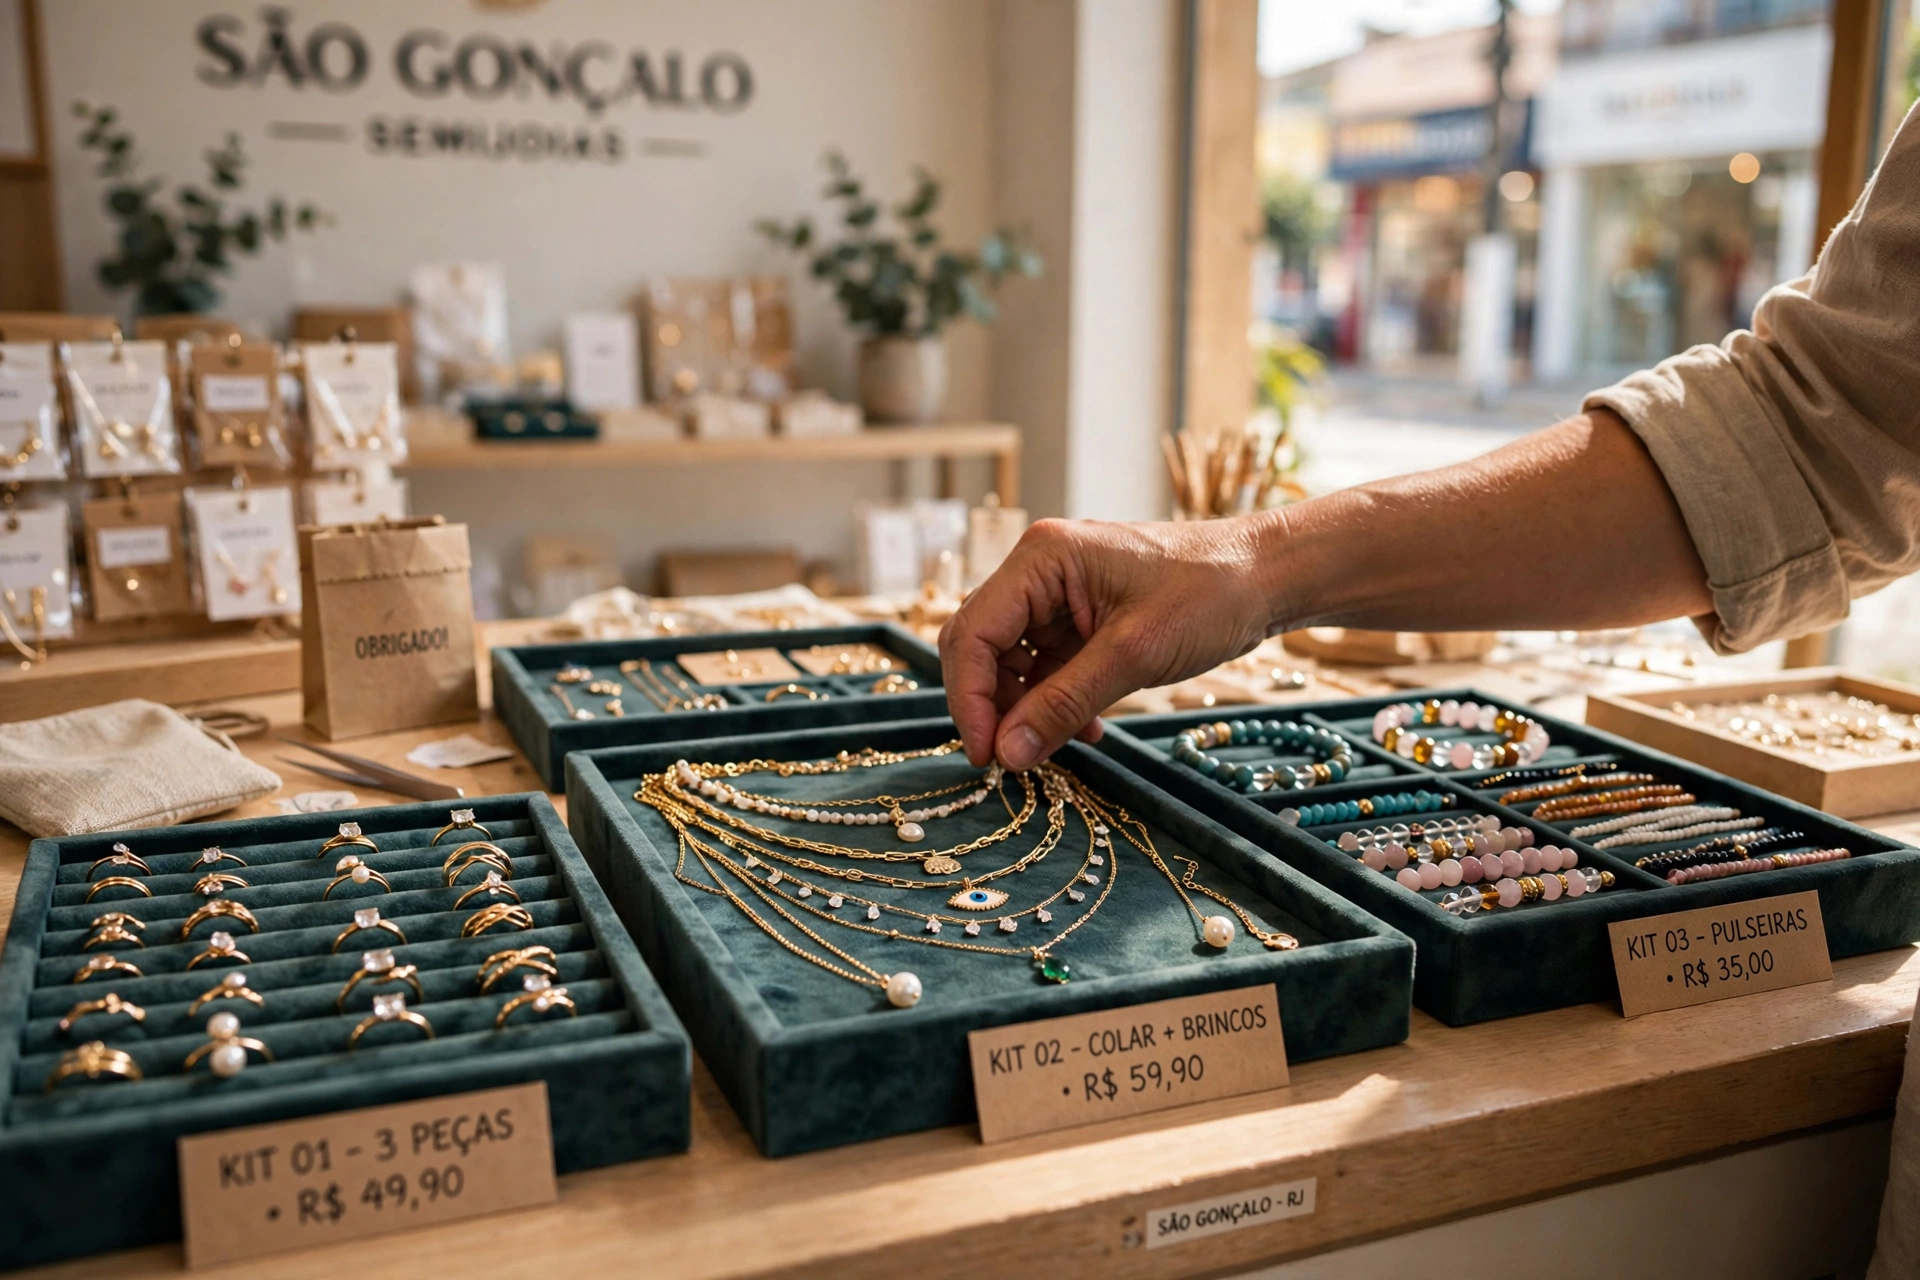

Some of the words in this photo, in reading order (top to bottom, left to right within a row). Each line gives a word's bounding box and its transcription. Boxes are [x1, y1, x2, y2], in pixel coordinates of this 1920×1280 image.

[196, 5, 371, 95] SÃO
[394, 26, 754, 116] GONÇALO
[356, 627, 449, 659] OBRIGADO!
[1627, 933, 1657, 960] KIT
[1665, 928, 1690, 953] 03
[1711, 909, 1808, 945] PULSEIRAS
[1683, 958, 1709, 988] R$
[1717, 950, 1774, 982] 35,00
[989, 1045, 1026, 1075] KIT
[1035, 1040, 1064, 1067] 02
[1088, 1023, 1157, 1057] COLAR
[1182, 1005, 1267, 1041] BRINCOS
[1084, 1067, 1118, 1101] R$
[1130, 1054, 1204, 1092] 59,90
[219, 1146, 278, 1188] KIT
[290, 1138, 332, 1176] 01
[374, 1127, 398, 1161] 3
[411, 1108, 515, 1157] PEÇAS
[298, 1181, 346, 1226] R$
[361, 1164, 465, 1212] 49,90
[1157, 1212, 1191, 1238] SÃO
[1196, 1196, 1272, 1230] GONÇALO
[1287, 1189, 1305, 1207] RJ
